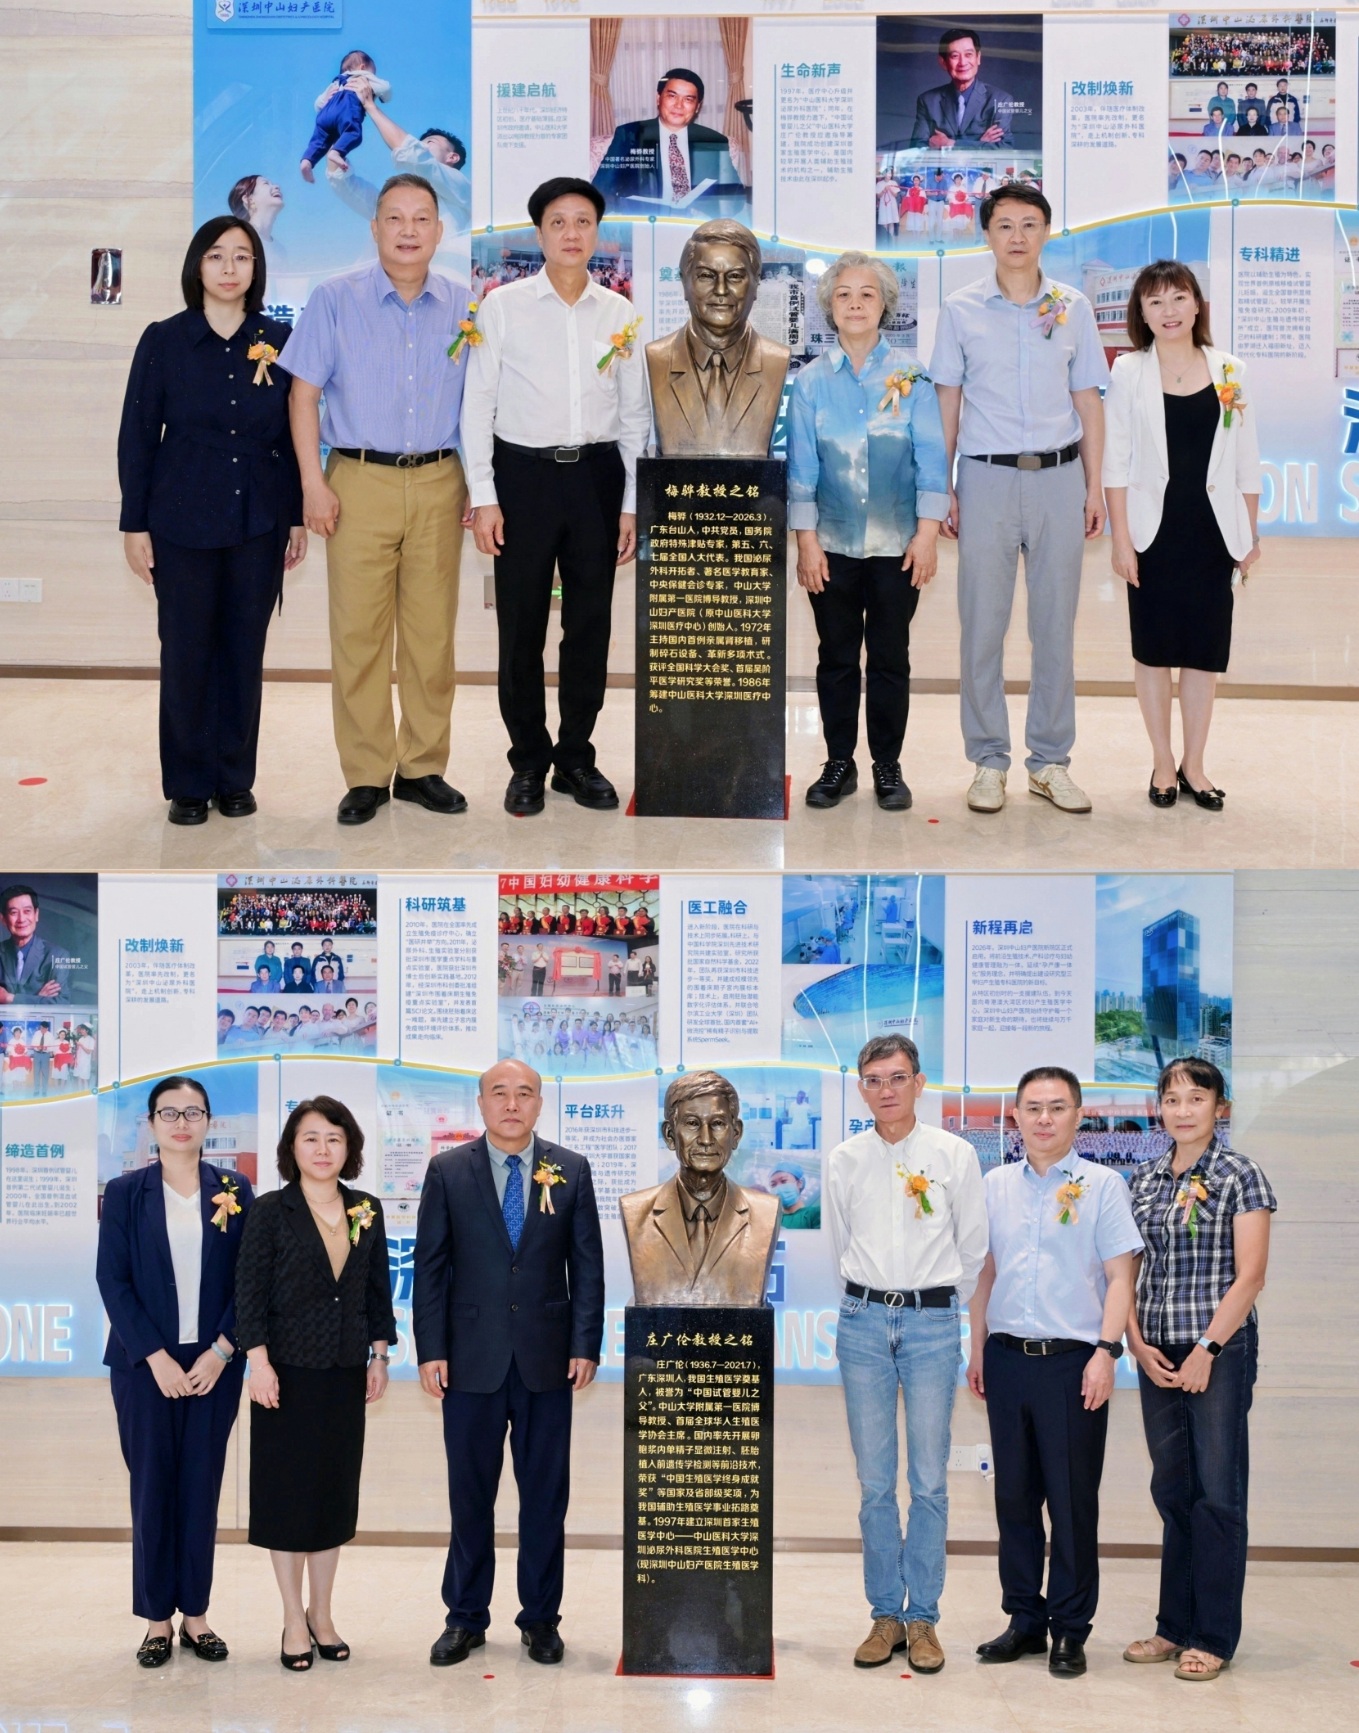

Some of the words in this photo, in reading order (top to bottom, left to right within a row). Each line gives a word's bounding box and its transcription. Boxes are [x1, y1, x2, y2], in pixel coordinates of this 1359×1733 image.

[238, 1, 335, 13] 深圳中山妇产医院
[781, 63, 841, 78] 生命新声
[497, 83, 556, 98] 援建启航
[1072, 81, 1133, 96] 改制焕新
[1239, 247, 1300, 262] 专科精进
[665, 483, 760, 498] 梅骅教授之铭
[650, 525, 772, 536] 广东台山人，中共党员，国务院
[650, 539, 773, 550] 政府特殊津贴专家，第五、六、
[650, 552, 772, 563] 七届全国人大代表。我国泌尿
[650, 566, 773, 577] 外科开拓者、著名医学教育家、
[650, 580, 771, 590] 中央保健会诊专家，中山大学
[650, 594, 772, 604] 附属第一医院博导教授，深圳中
[650, 608, 771, 618] 山妇产医院（原中山医科大学
[650, 622, 771, 632] 深圳医疗中心）创始人。1972年
[650, 635, 771, 646] 主持国内首例亲属肾移植，研
[650, 649, 771, 660] 制碎石设备、革新多项术式。
[650, 663, 770, 674] 获评全国科学大会奖、首届吴阶
[650, 676, 771, 687] 平医学研究奖等荣誉。1986年
[650, 690, 771, 700] 筹建中山医科大学深圳医疗中
[650, 704, 663, 713] 心。
[406, 897, 466, 912] 科研筑基
[688, 900, 747, 914] 医工融合
[973, 920, 1032, 935] 新程再启
[125, 938, 184, 953] 改制焕新
[565, 1104, 624, 1119] 平台跃升
[5, 1143, 65, 1158] 缔造首例
[646, 1332, 753, 1347] 庄广伦教授之铭
[638, 1374, 760, 1383] 广东深圳人，我国生殖医学奠基
[638, 1387, 760, 1397] 人，被誉为“中国试管婴儿之
[638, 1401, 760, 1412] 父”。中山大学附属第一医院博
[638, 1416, 760, 1426] 导教授、首届全球华人生殖医
[638, 1430, 760, 1440] 学协会主席。国内率先开展卵
[638, 1445, 760, 1455] 胞浆内单精子显微注射、胚胎
[638, 1460, 760, 1470] 植入前遗传学检测等前沿技术，
[638, 1474, 759, 1484] 荣获“中国生殖医学终身成就
[638, 1488, 759, 1499] 奖”等国家及省部级奖项，为
[638, 1502, 759, 1513] 我国辅助生殖医学事业拓路奠
[638, 1516, 759, 1527] 基。1997年建立深圳首家生殖
[637, 1546, 758, 1556] 圳泌尿外科医院生殖医学中心
